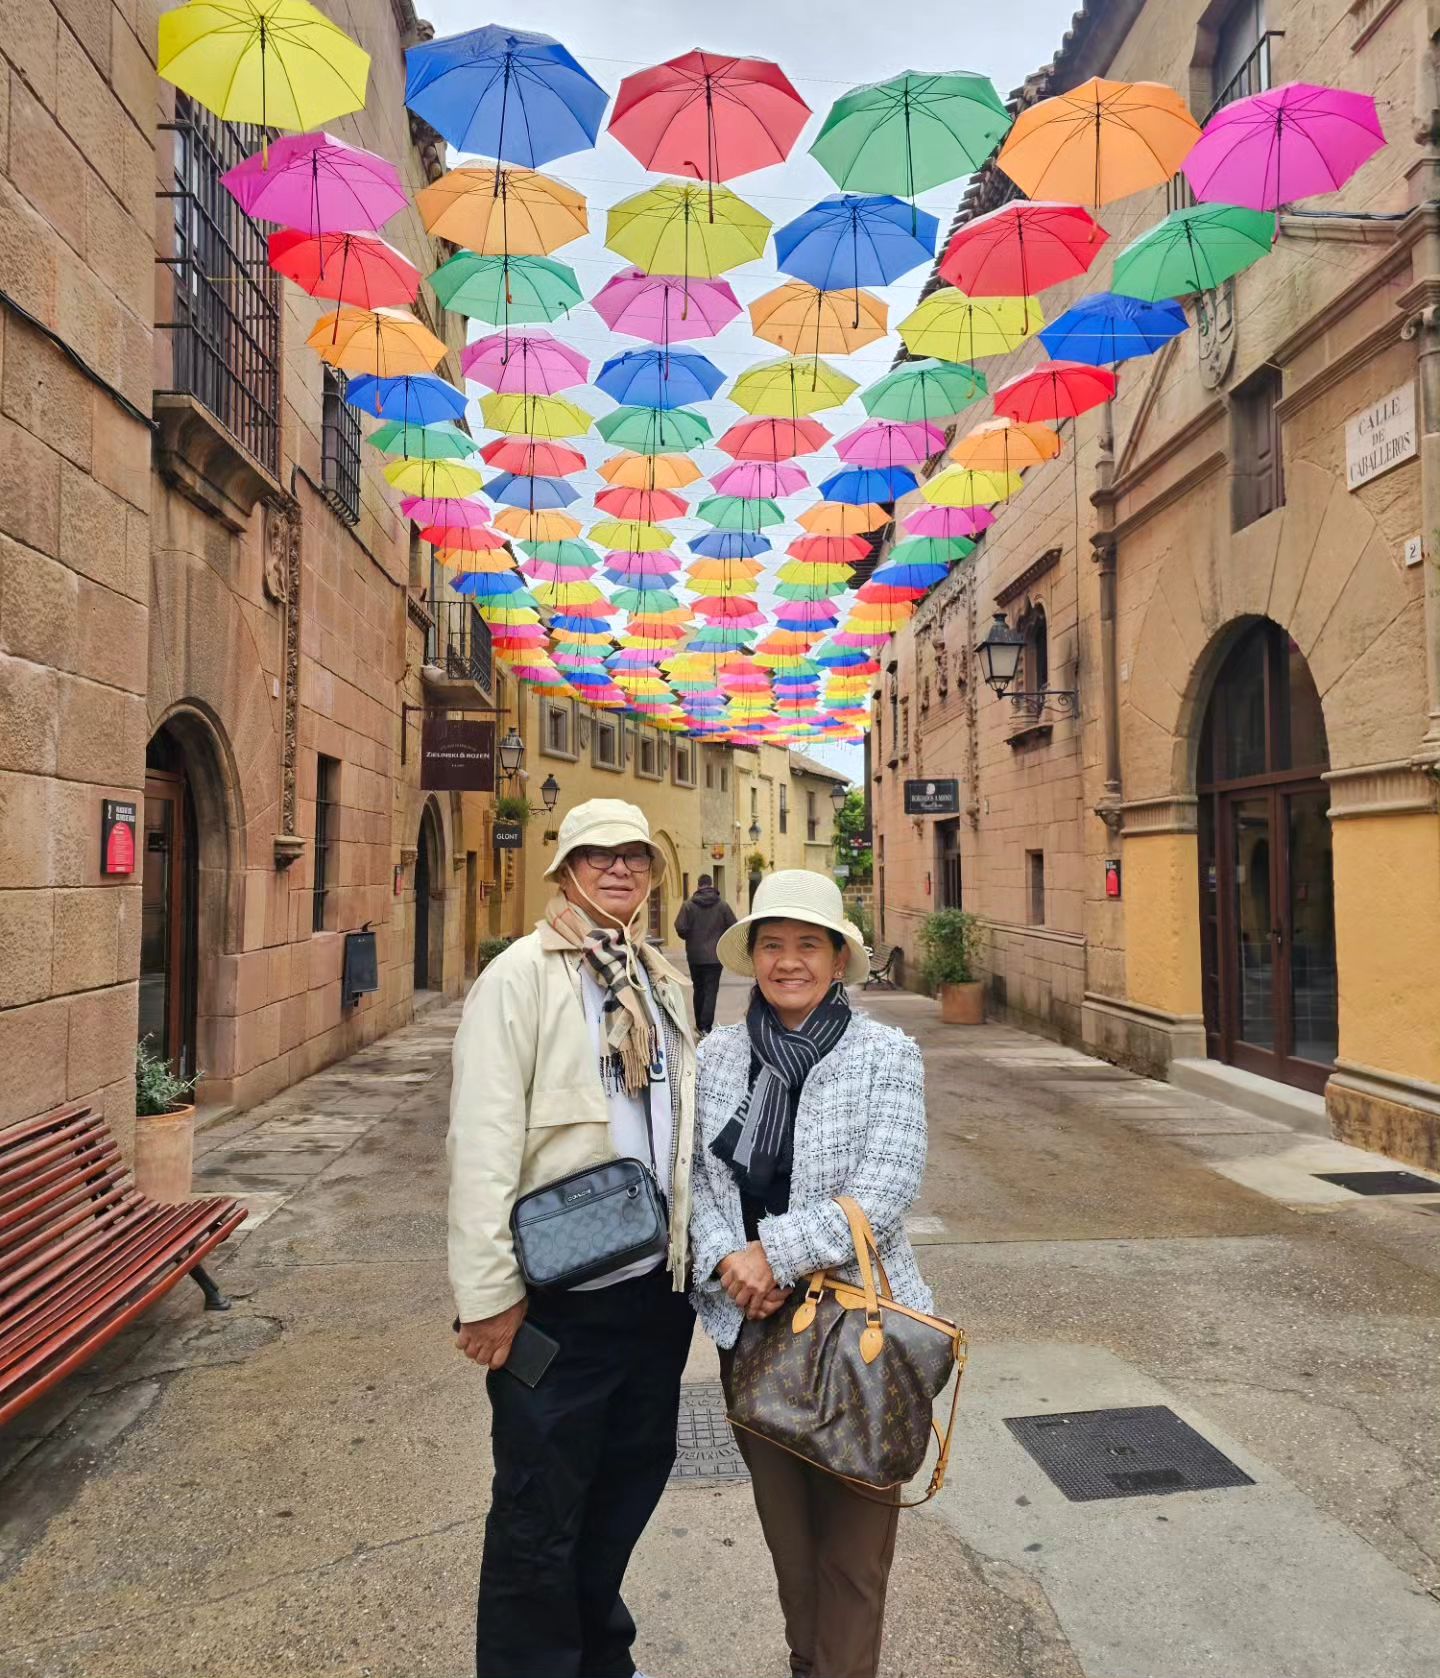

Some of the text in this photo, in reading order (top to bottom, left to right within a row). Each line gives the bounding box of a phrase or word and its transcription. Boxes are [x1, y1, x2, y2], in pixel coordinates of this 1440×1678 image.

[1358, 396, 1401, 436] CALLE
[1372, 428, 1385, 446] DE
[1349, 431, 1411, 482] CABALLEROS
[1409, 544, 1416, 559] 2
